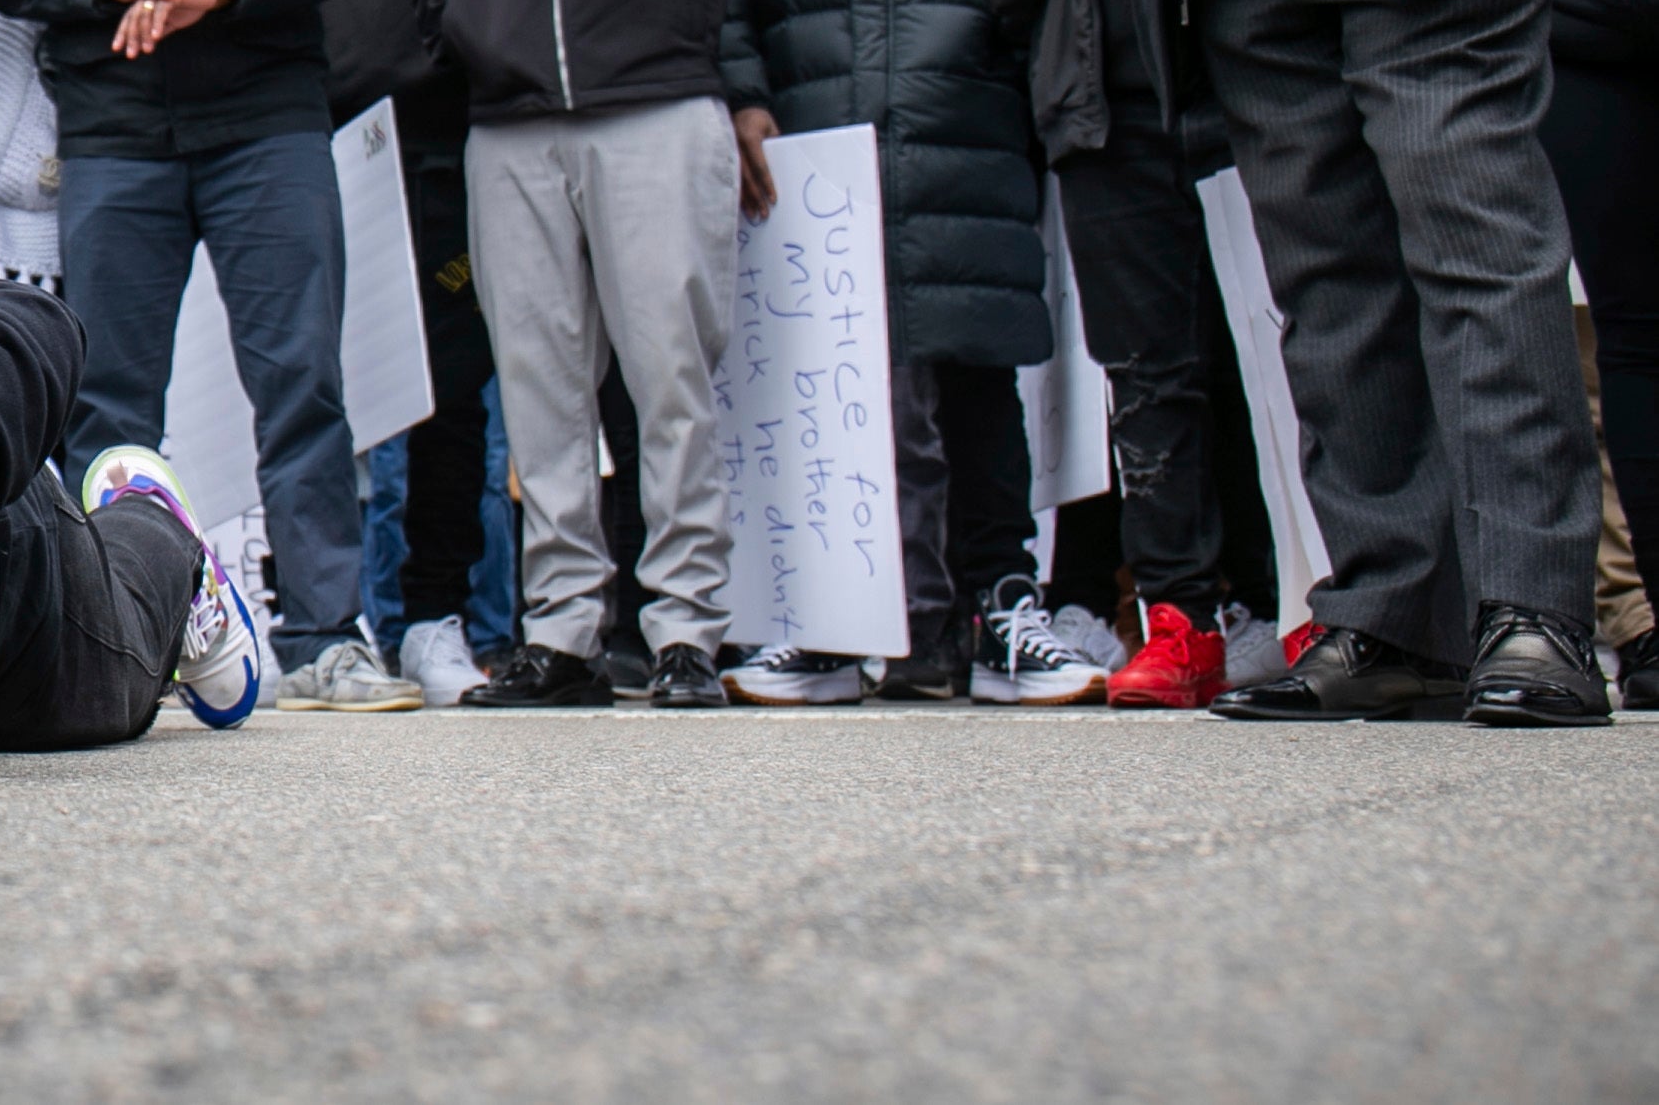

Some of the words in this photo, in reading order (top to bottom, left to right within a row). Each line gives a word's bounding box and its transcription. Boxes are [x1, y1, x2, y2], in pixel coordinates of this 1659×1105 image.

[736, 212, 771, 385] atrick
[753, 418, 784, 478] he
[765, 242, 814, 318] my
[793, 368, 836, 551] brother
[844, 472, 880, 578] for
